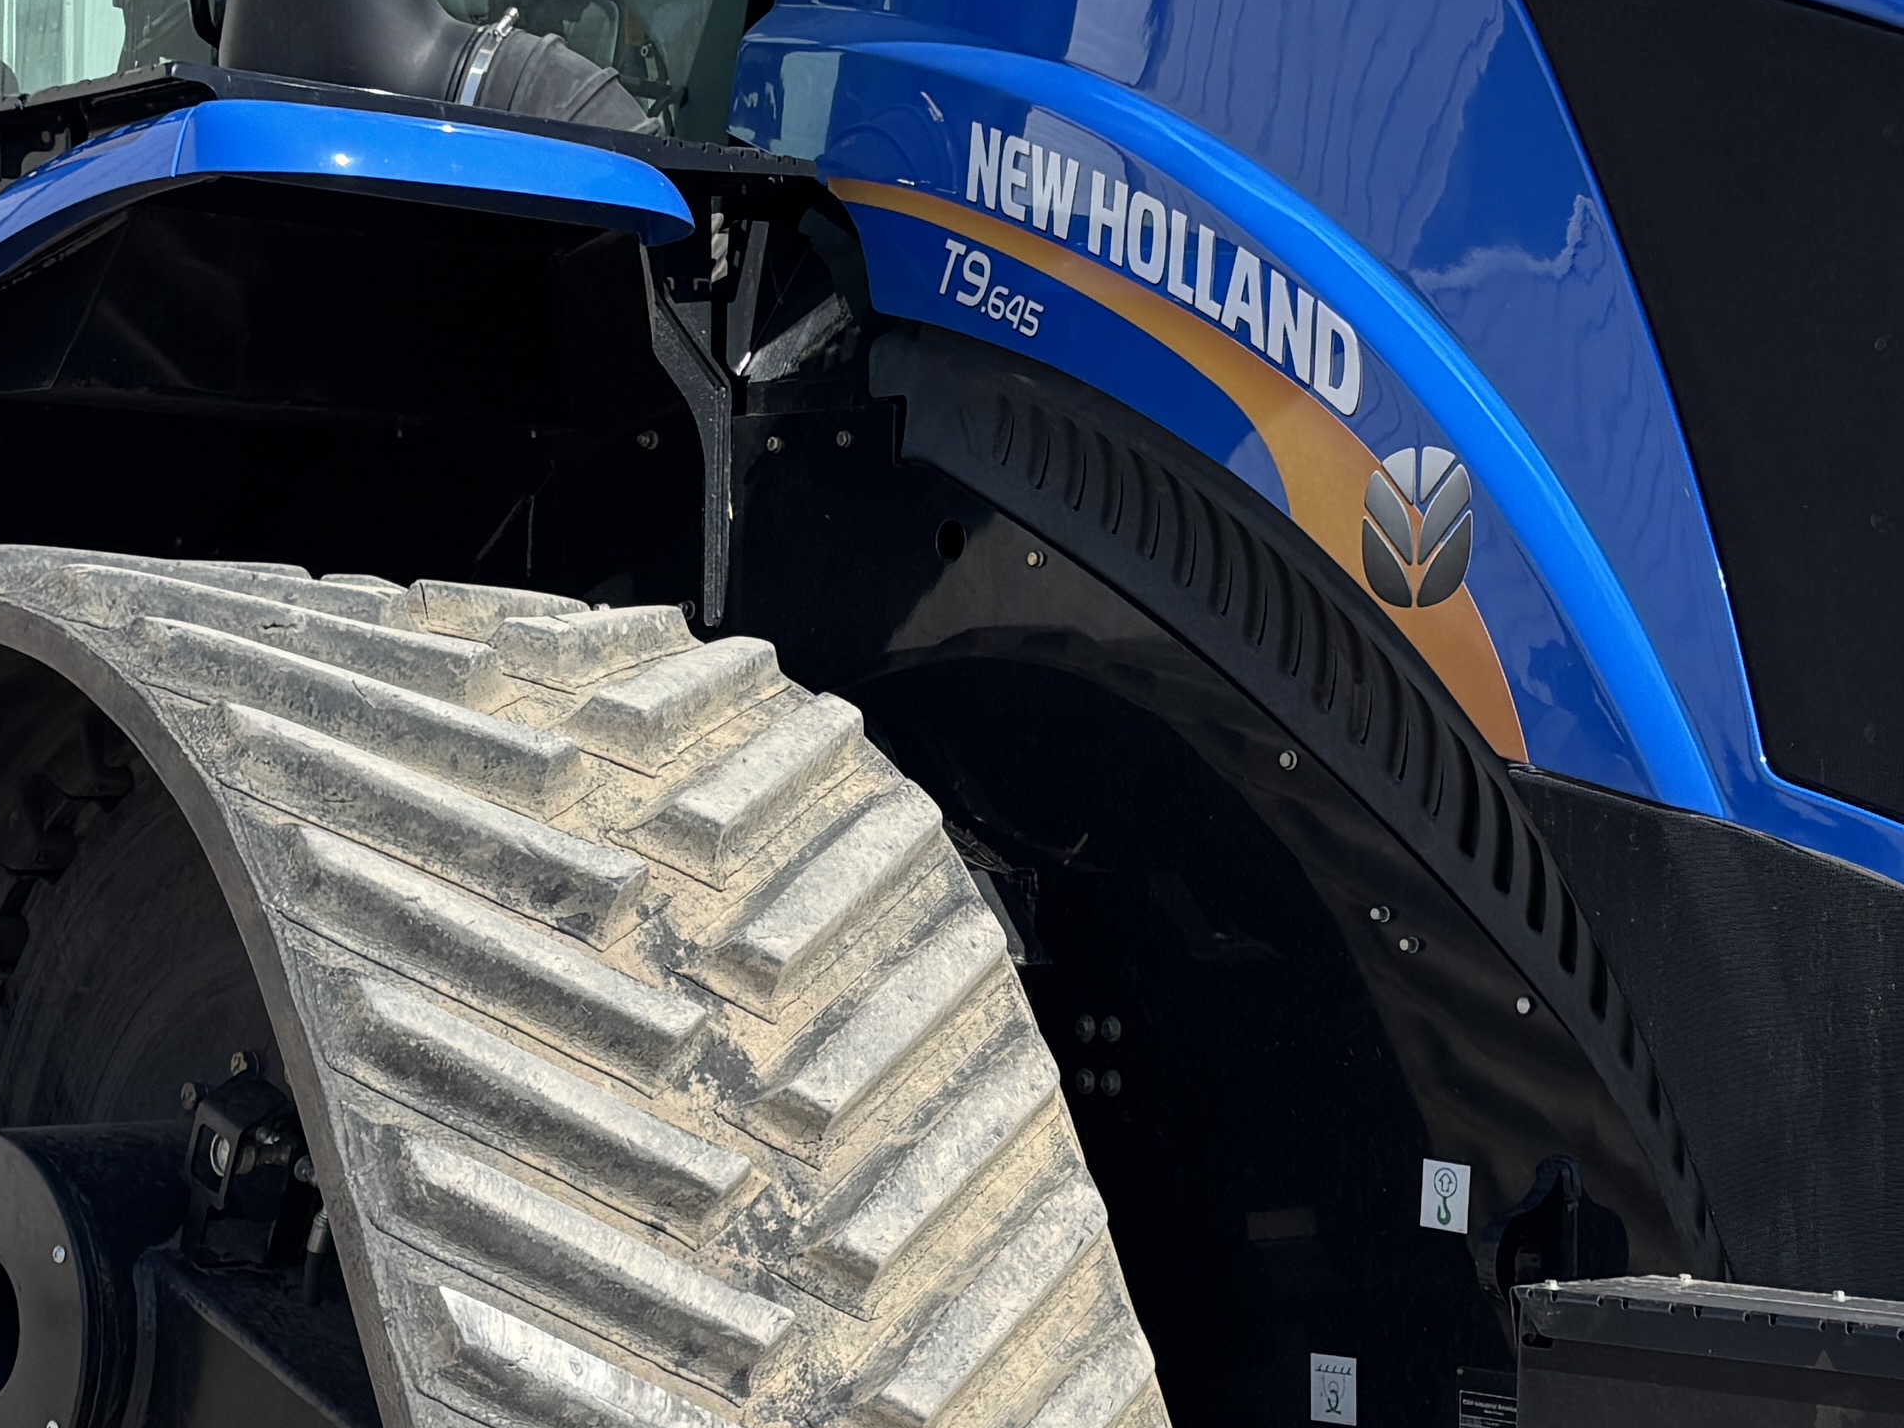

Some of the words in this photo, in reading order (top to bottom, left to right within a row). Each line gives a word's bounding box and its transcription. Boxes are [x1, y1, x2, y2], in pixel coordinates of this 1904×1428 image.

[939, 240, 1045, 337] T9.645
[966, 121, 1077, 240] NEW
[1087, 171, 1361, 416] HOLLAND
